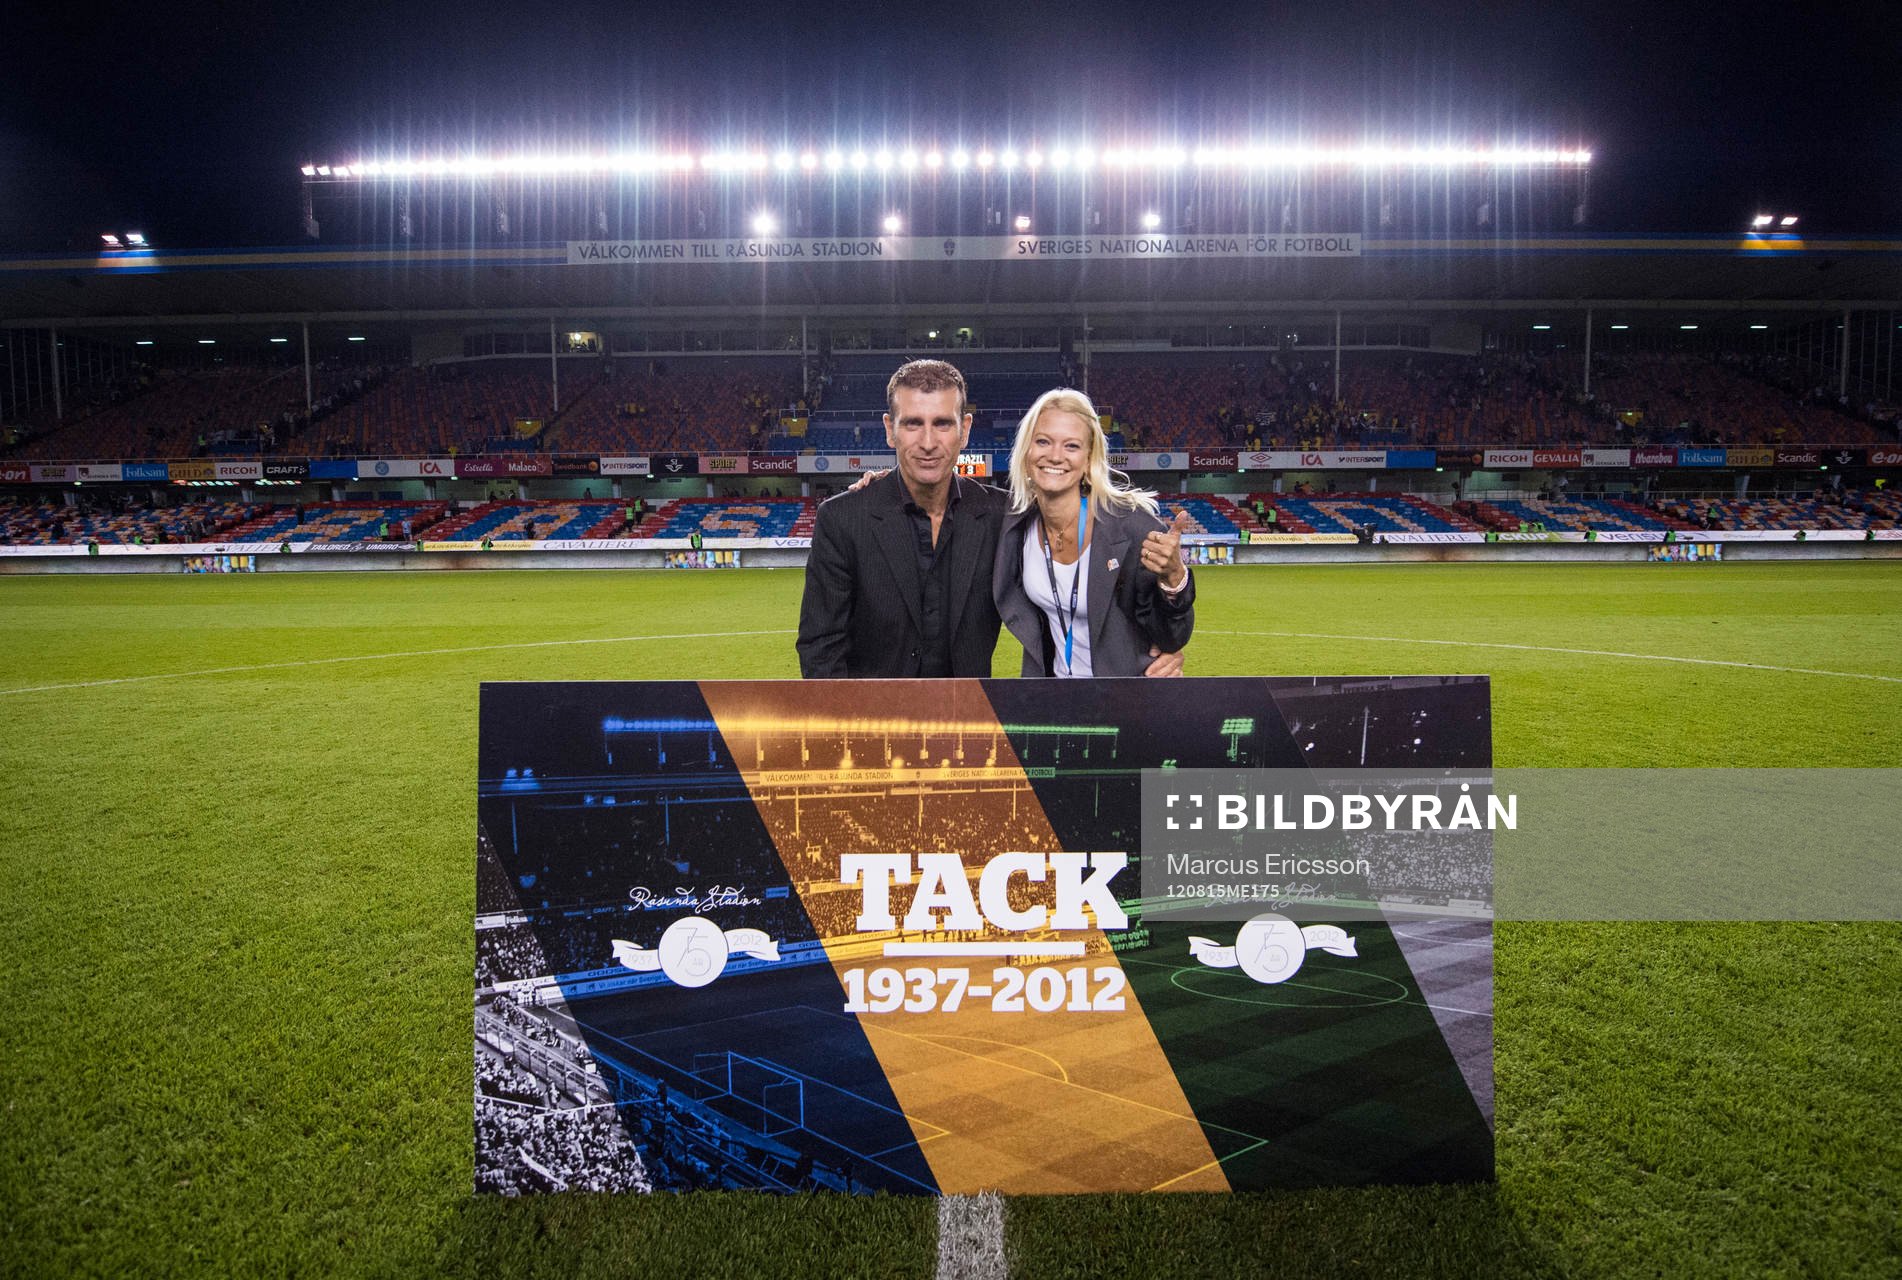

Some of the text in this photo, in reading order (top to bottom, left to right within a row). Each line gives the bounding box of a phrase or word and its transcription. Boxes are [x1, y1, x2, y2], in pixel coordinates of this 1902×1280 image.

[578, 240, 882, 259] VÄLKOMMEN TILL RÅSUNDA STADION
[1018, 236, 1353, 254] SVERIGES NATIONALARENA FÖR FOTBOLL
[1193, 456, 1235, 465] Scandic
[1301, 454, 1324, 465] ICA
[1489, 455, 1528, 463] RICOH
[1534, 454, 1580, 463] GEVALIA
[1682, 452, 1723, 464] Folksam
[1777, 453, 1817, 463] Scandic
[266, 466, 299, 474] CRAFT
[419, 462, 442, 474] ICA
[464, 463, 493, 472] Estrella
[508, 461, 537, 472] Malaco
[752, 459, 793, 470] Scandic
[126, 467, 166, 478] Folksam
[220, 466, 258, 475] RICOH
[840, 851, 1129, 931] TACK
[694, 885, 762, 914] Stadion
[733, 934, 763, 947] 2012
[1310, 929, 1340, 943] 2012
[843, 966, 1127, 1013] 1937-2012
